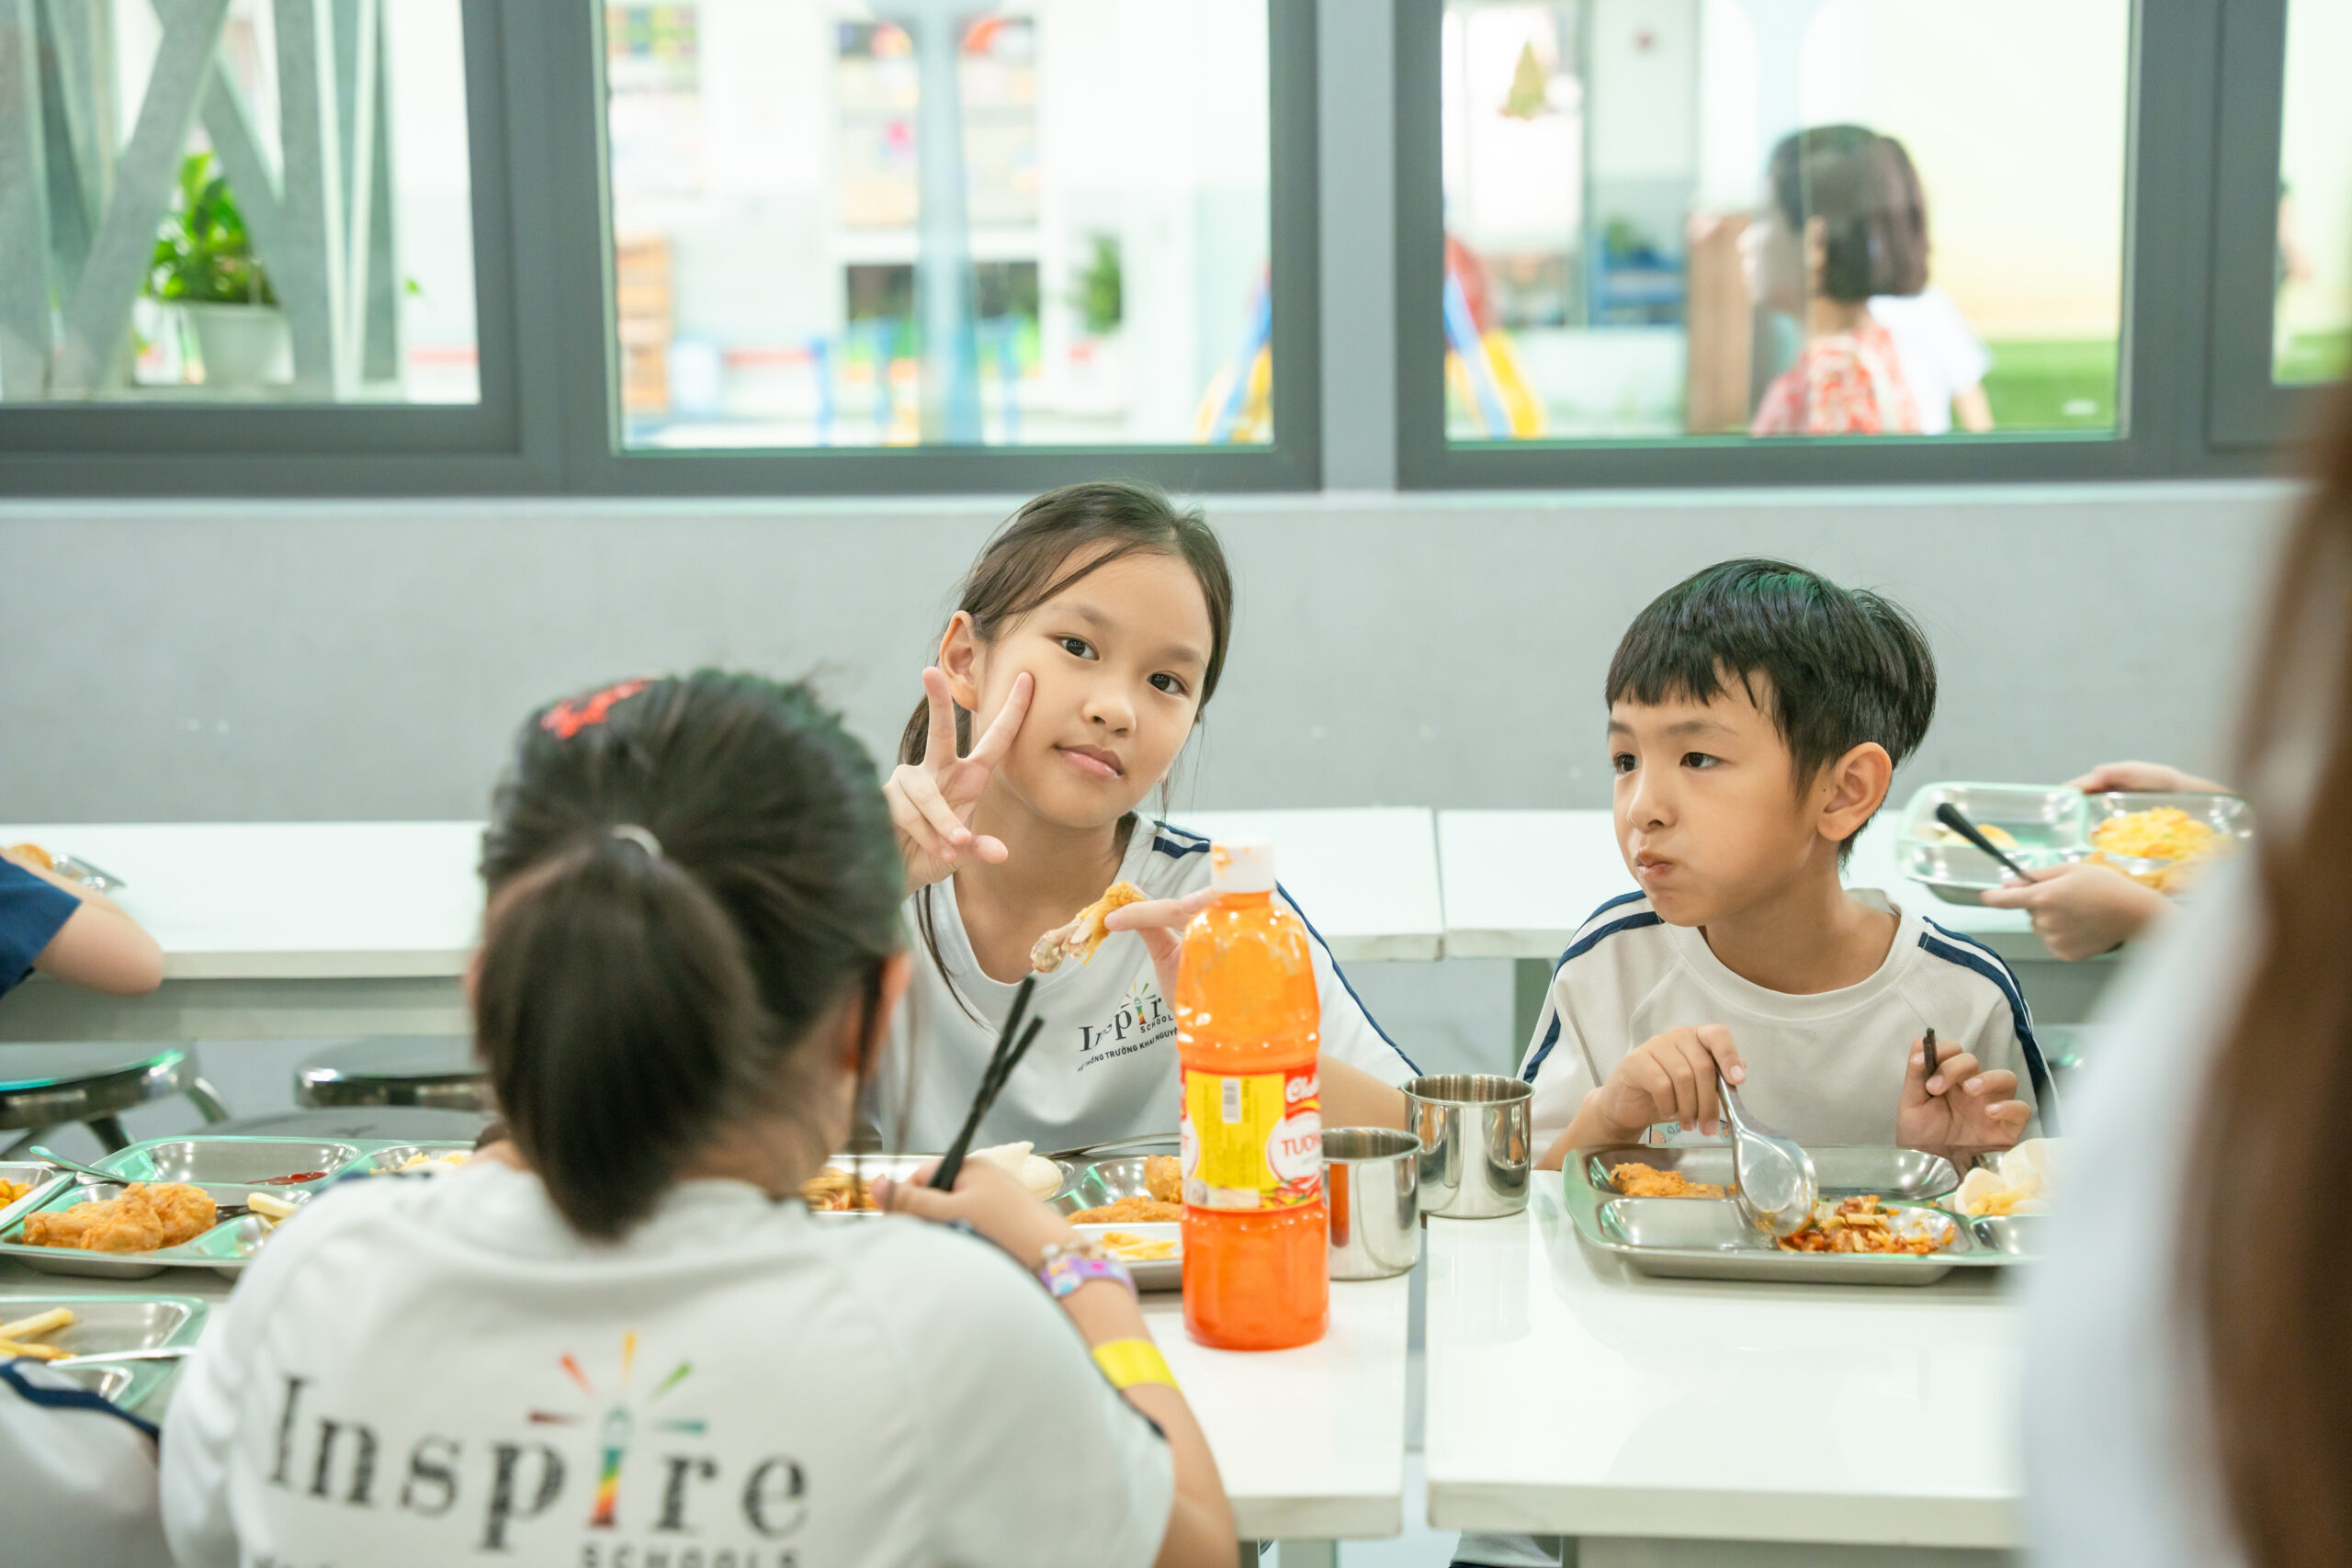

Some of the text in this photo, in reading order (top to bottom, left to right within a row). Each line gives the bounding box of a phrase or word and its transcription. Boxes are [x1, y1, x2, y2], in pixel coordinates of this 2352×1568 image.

[1140, 1014, 1173, 1033] SCHOOL
[1139, 1037, 1155, 1050] KHAI
[1155, 1026, 1179, 1042] NGUYÊ
[267, 1374, 809, 1554] Inspire
